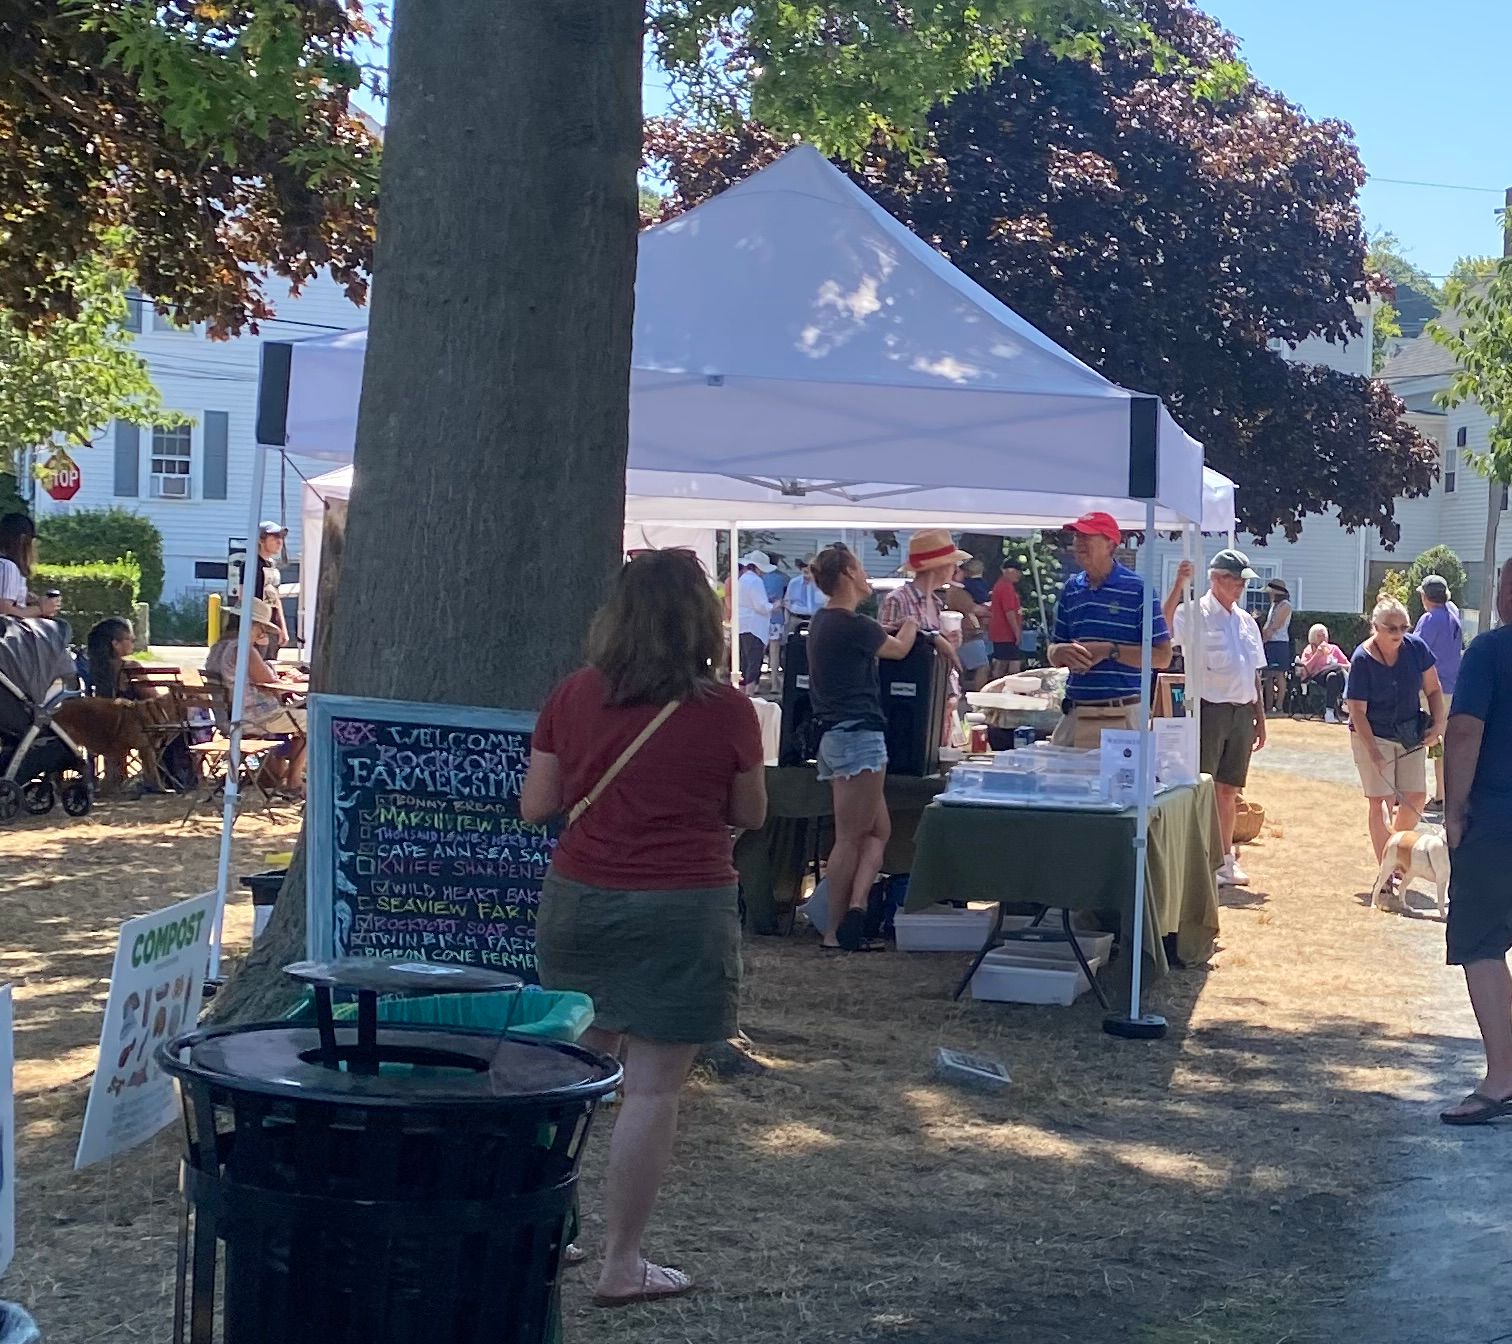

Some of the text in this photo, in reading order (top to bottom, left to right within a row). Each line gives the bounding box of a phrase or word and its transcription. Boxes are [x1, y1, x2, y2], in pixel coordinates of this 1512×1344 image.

[52, 469, 79, 487] TOP
[388, 727, 525, 753] WELCOME
[501, 817, 547, 838] FARM
[378, 842, 427, 859] CAPE
[433, 843, 470, 859] ANN
[476, 846, 512, 862] SEA
[378, 859, 442, 877] KNIFE
[392, 882, 435, 899] WILD
[443, 886, 500, 905] HEART
[376, 896, 467, 917] SEAVIEW
[372, 916, 458, 934] ROCKPORT
[467, 922, 508, 938] SOAP
[132, 910, 205, 969] COMPOST
[370, 933, 417, 948] TWIN
[423, 934, 477, 949] BIRCH
[365, 946, 426, 962] PIGEON
[432, 950, 475, 964] COVE
